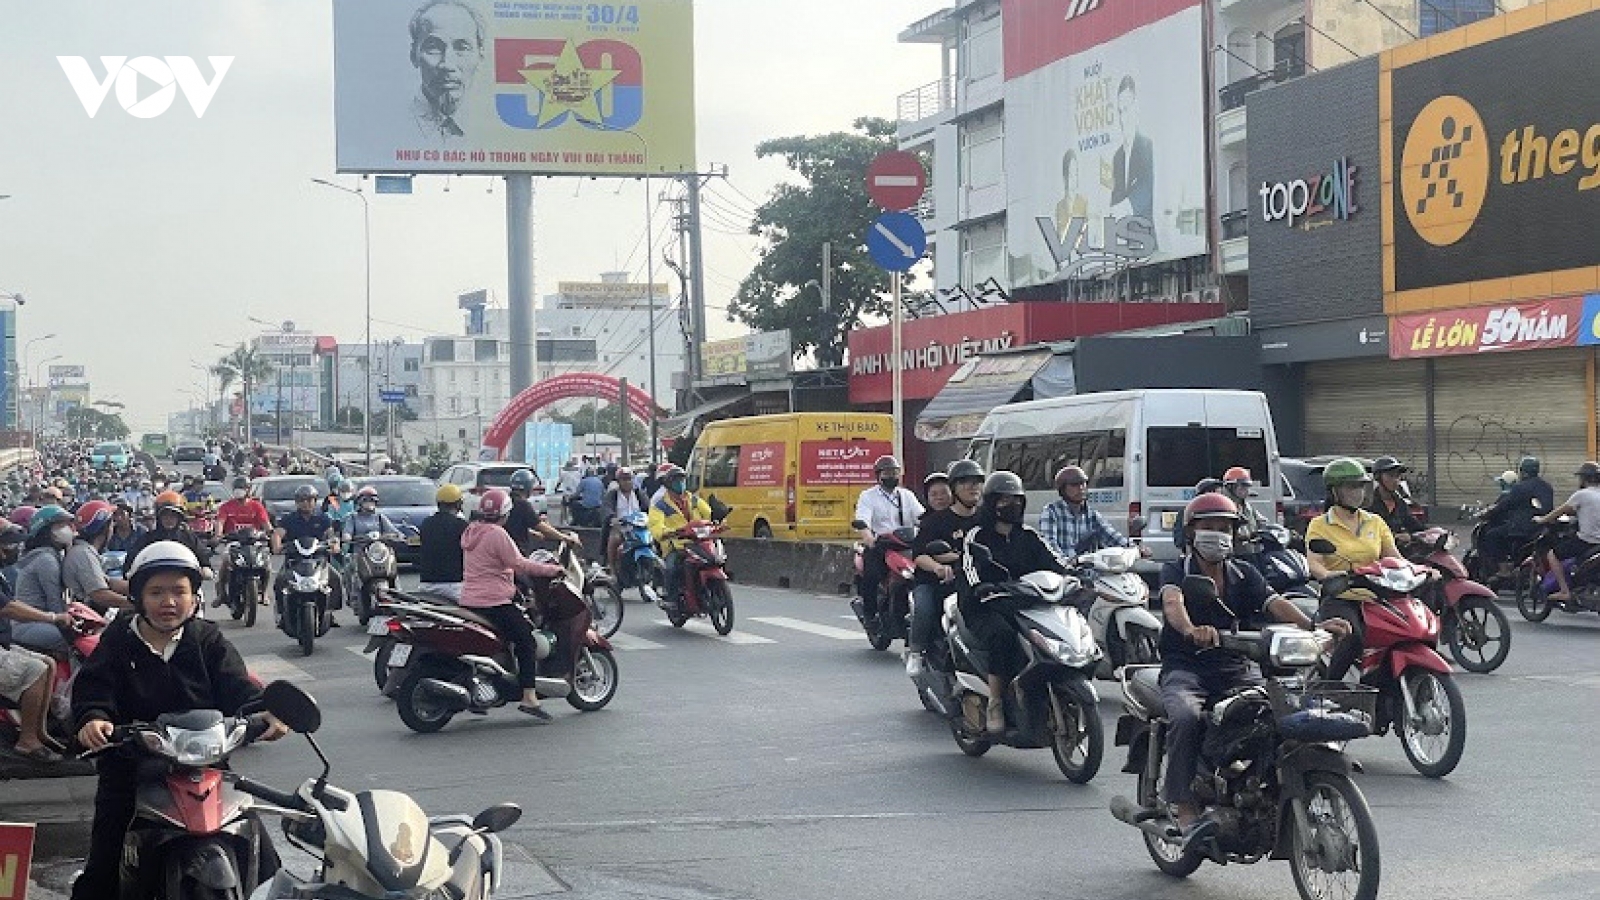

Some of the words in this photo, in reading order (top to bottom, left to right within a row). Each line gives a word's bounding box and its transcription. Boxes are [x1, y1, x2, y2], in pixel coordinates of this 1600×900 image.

[587, 4, 640, 24] 30/4
[489, 151, 526, 163] TRONG
[1435, 318, 1478, 349] LỚN
[852, 353, 882, 376] ANH
[916, 339, 942, 372] HỘI
[816, 422, 829, 433] XE
